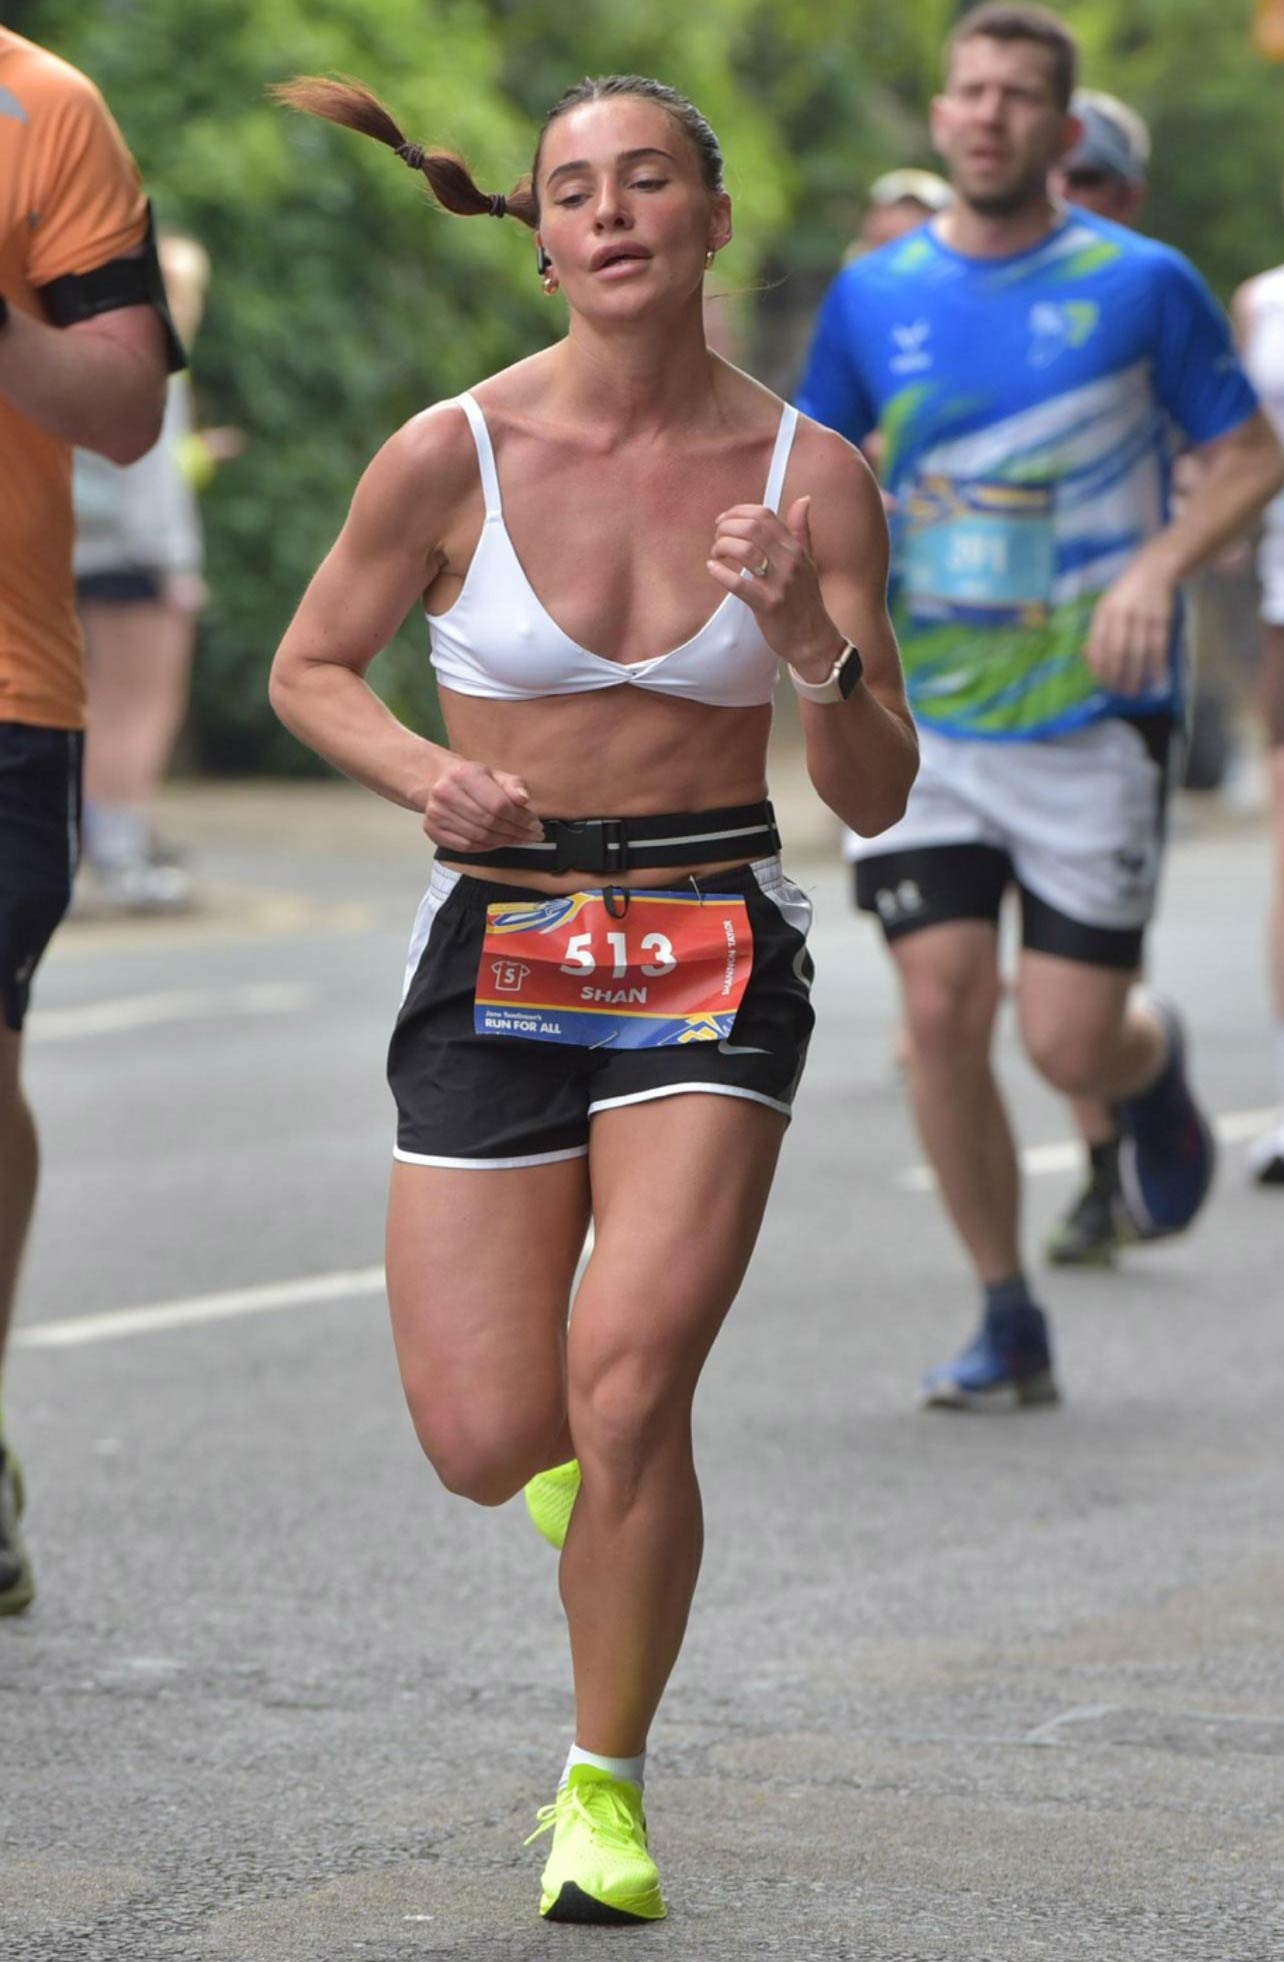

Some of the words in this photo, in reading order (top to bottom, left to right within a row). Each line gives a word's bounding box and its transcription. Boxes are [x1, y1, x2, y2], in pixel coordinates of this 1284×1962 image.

[560, 932, 677, 979] 513
[504, 967, 515, 984] S
[580, 986, 648, 1004] SHAN
[484, 1018, 512, 1029] RUN
[513, 1020, 537, 1032] FOR
[540, 1022, 562, 1034] ALL
